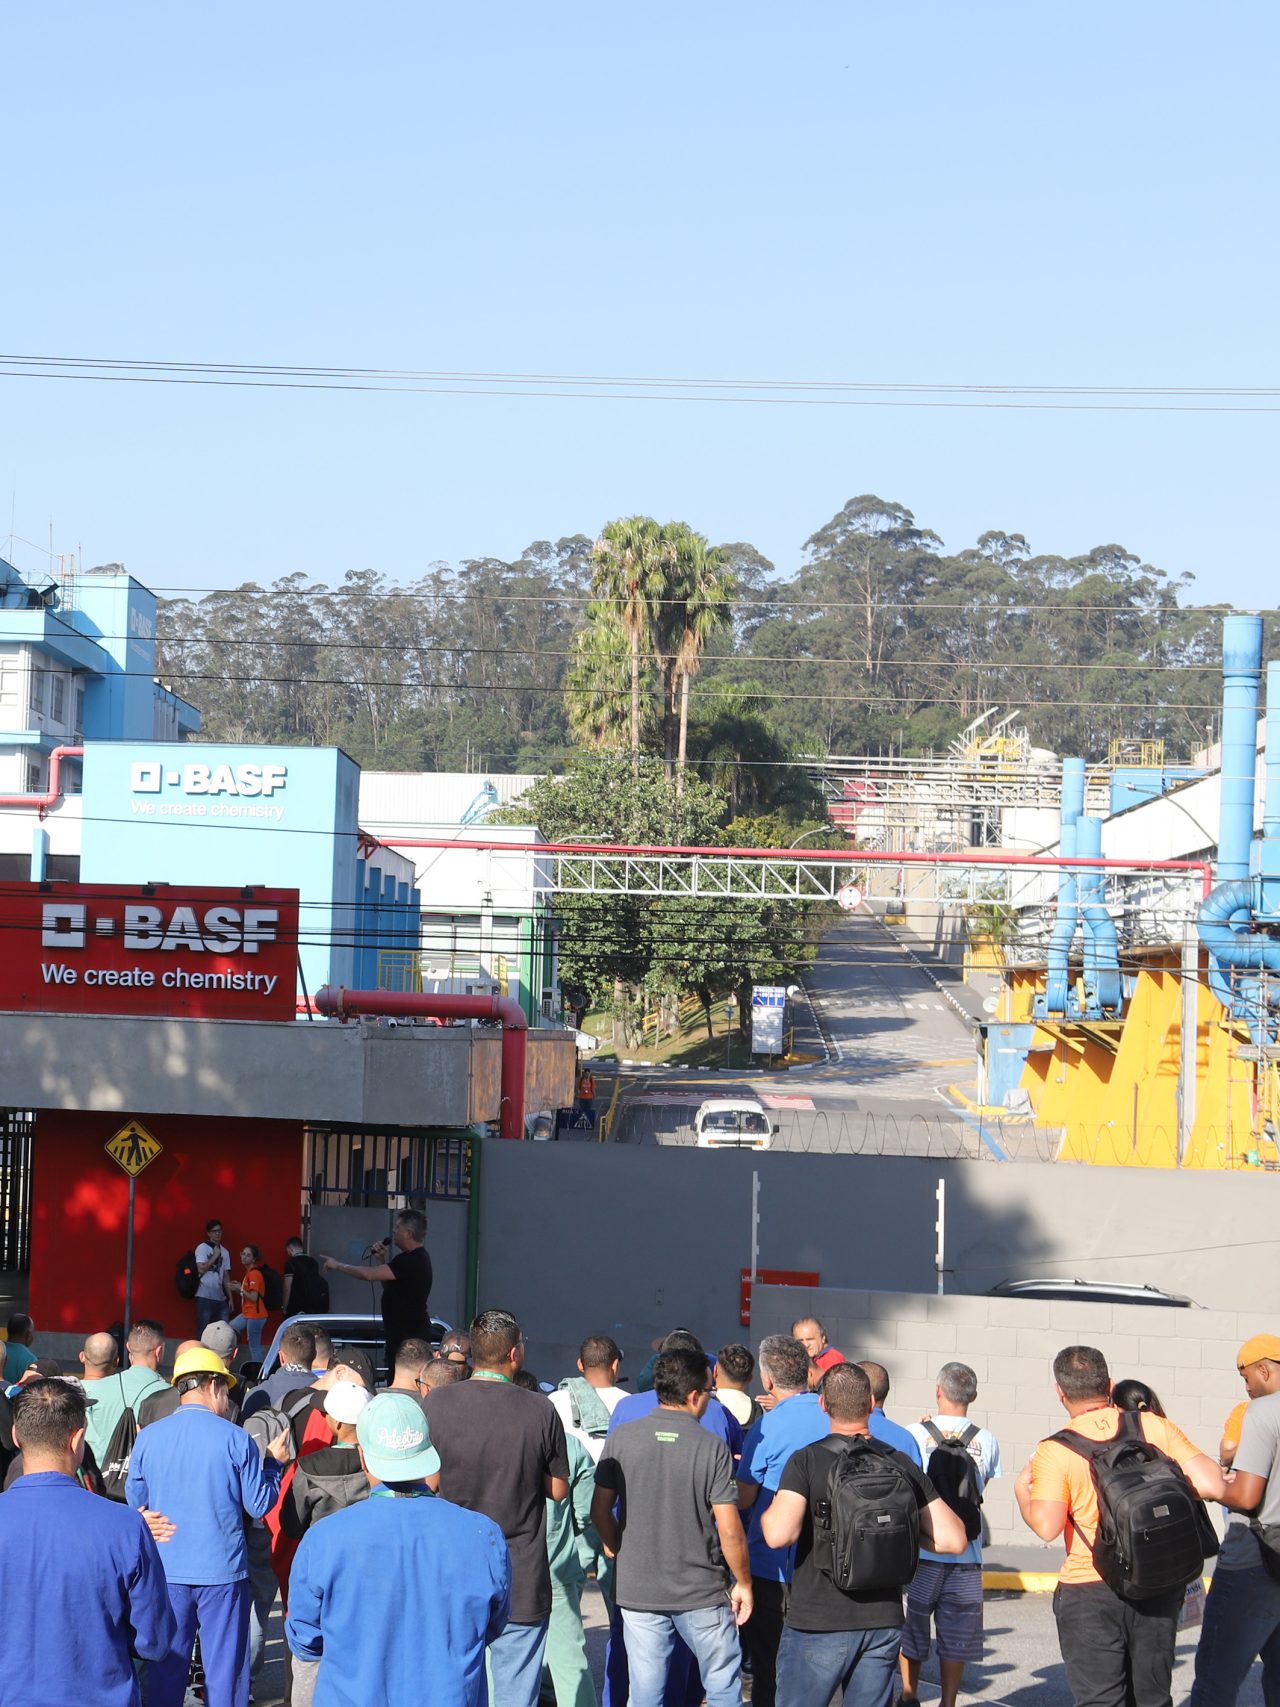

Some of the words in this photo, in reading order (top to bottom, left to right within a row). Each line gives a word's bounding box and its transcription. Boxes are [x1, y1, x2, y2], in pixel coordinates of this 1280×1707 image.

[184, 764, 287, 797] BASF
[130, 799, 155, 815] We
[159, 801, 207, 816] create
[211, 802, 285, 822] chemistry
[124, 904, 279, 954] BASF
[41, 963, 78, 985] We
[84, 967, 156, 988] create
[161, 967, 278, 996] chemistry
